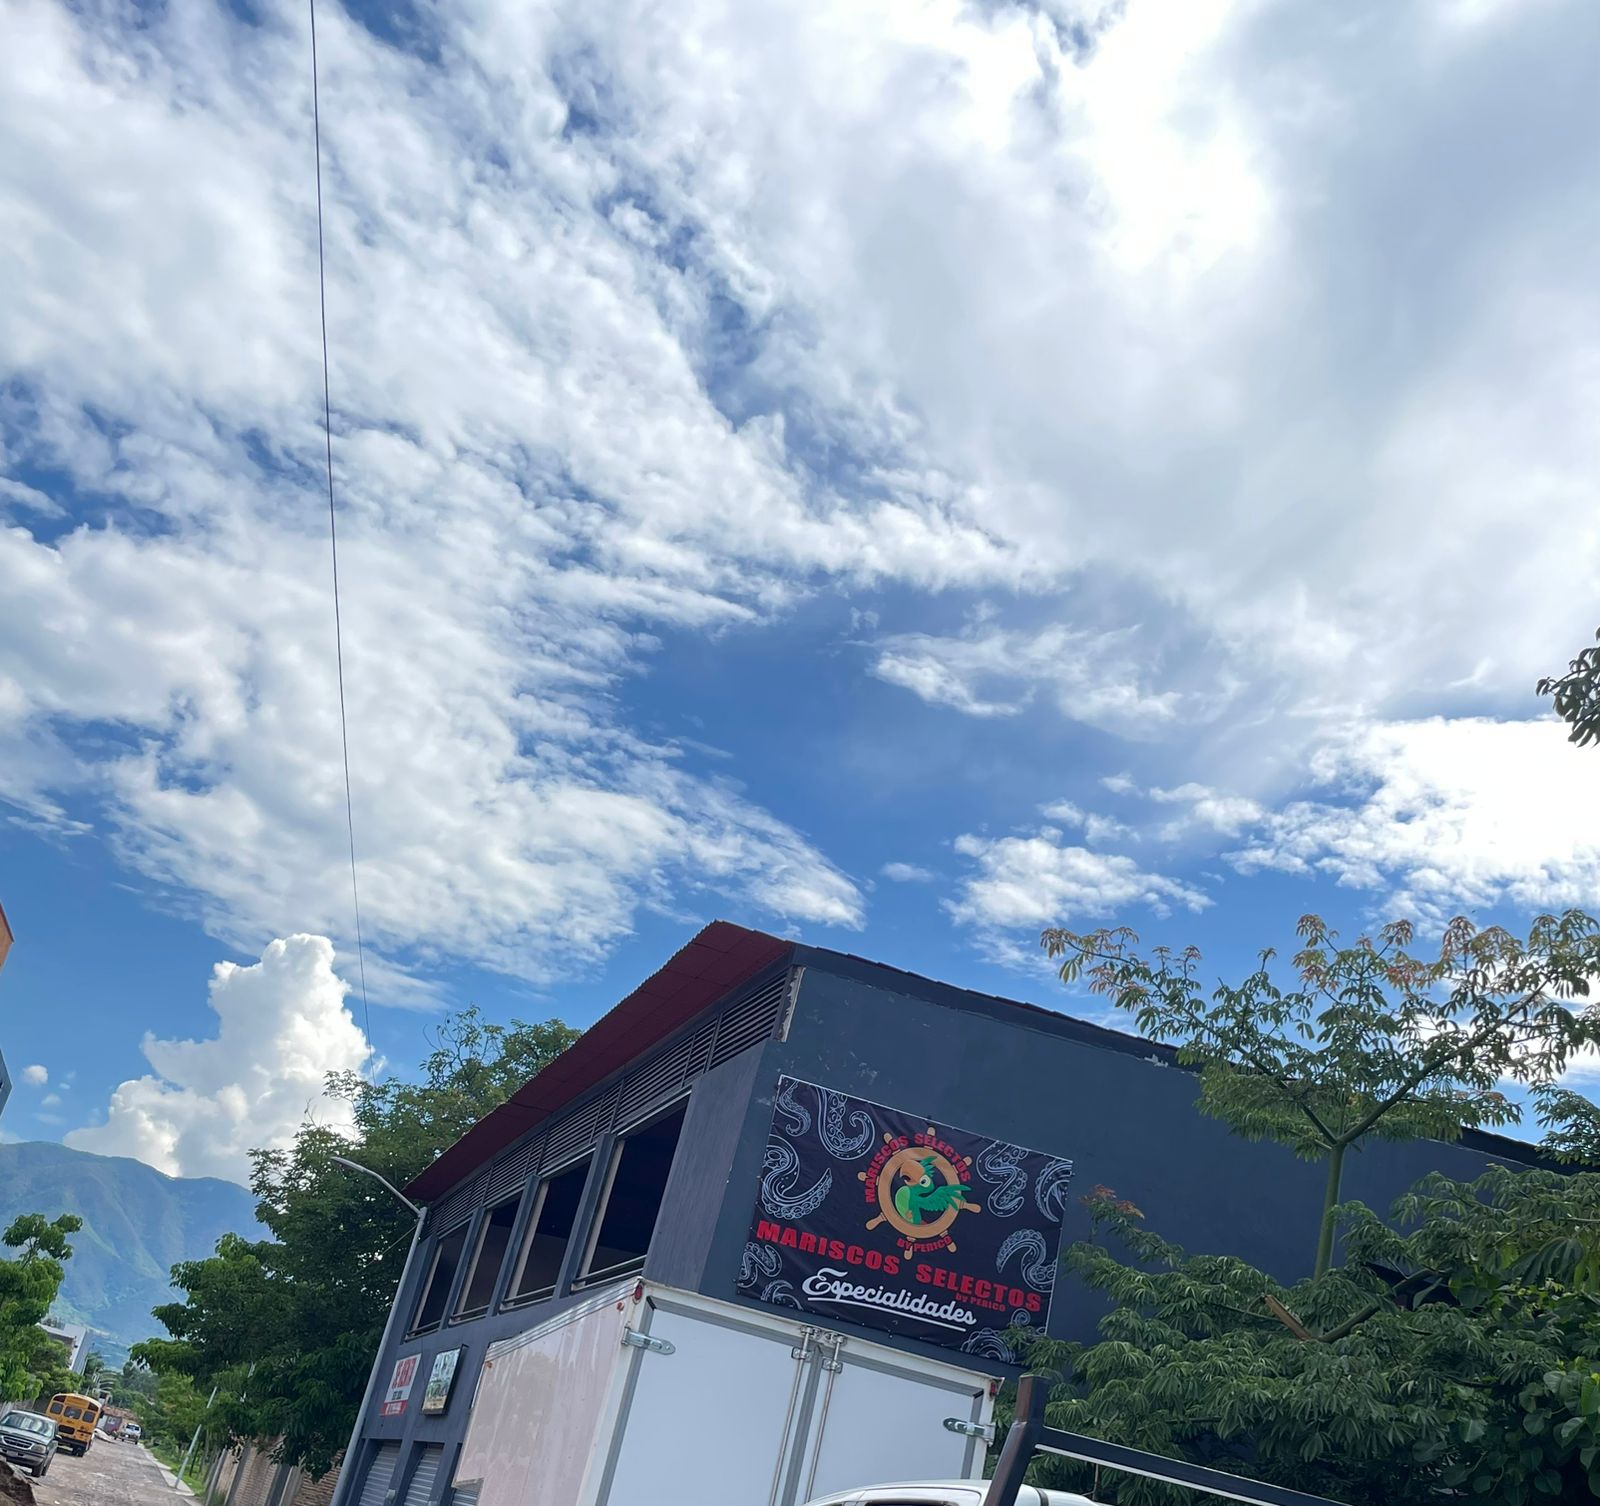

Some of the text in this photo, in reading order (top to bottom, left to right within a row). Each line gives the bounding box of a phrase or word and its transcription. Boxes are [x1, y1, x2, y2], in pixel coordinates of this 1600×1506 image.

[865, 1133, 971, 1203] MARISCOS SELECTOS
[756, 1220, 1042, 1312] MARISCOS SELECTOS
[897, 1235, 953, 1252] BY PERICO
[801, 1267, 977, 1326] Especialidades
[970, 1296, 1007, 1312] PERICO
